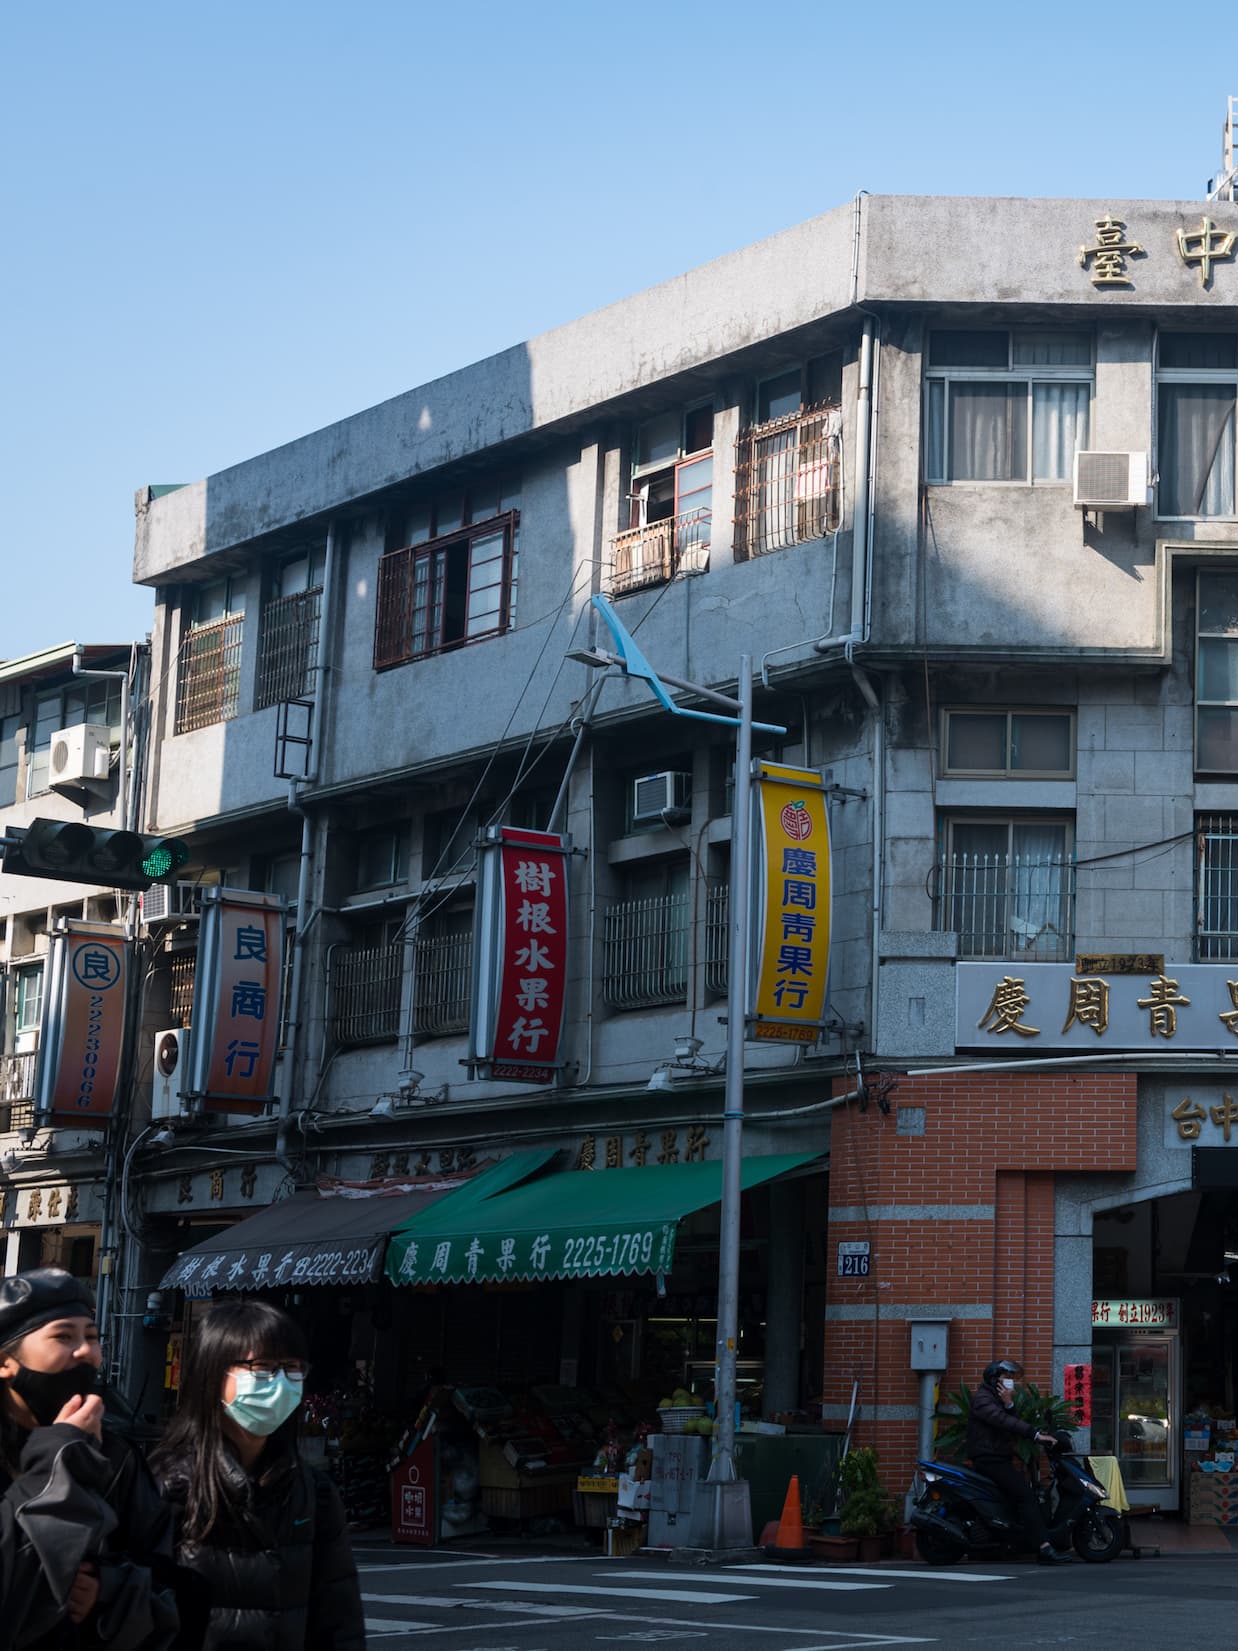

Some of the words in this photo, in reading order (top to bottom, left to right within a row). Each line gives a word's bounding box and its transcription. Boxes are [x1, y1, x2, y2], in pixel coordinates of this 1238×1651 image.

[773, 847, 817, 1010] 慶周青果行
[82, 951, 112, 982] 良
[507, 860, 557, 1054] 樹根水果行
[225, 924, 268, 1079] 良商行
[77, 996, 104, 1108] 22230066
[493, 1063, 549, 1080] 2222-2234
[306, 1248, 377, 1277] 2222-2234
[398, 1232, 552, 1277] 慶周青果行
[562, 1231, 654, 1269] 2225-1769
[844, 1255, 869, 1275] 216
